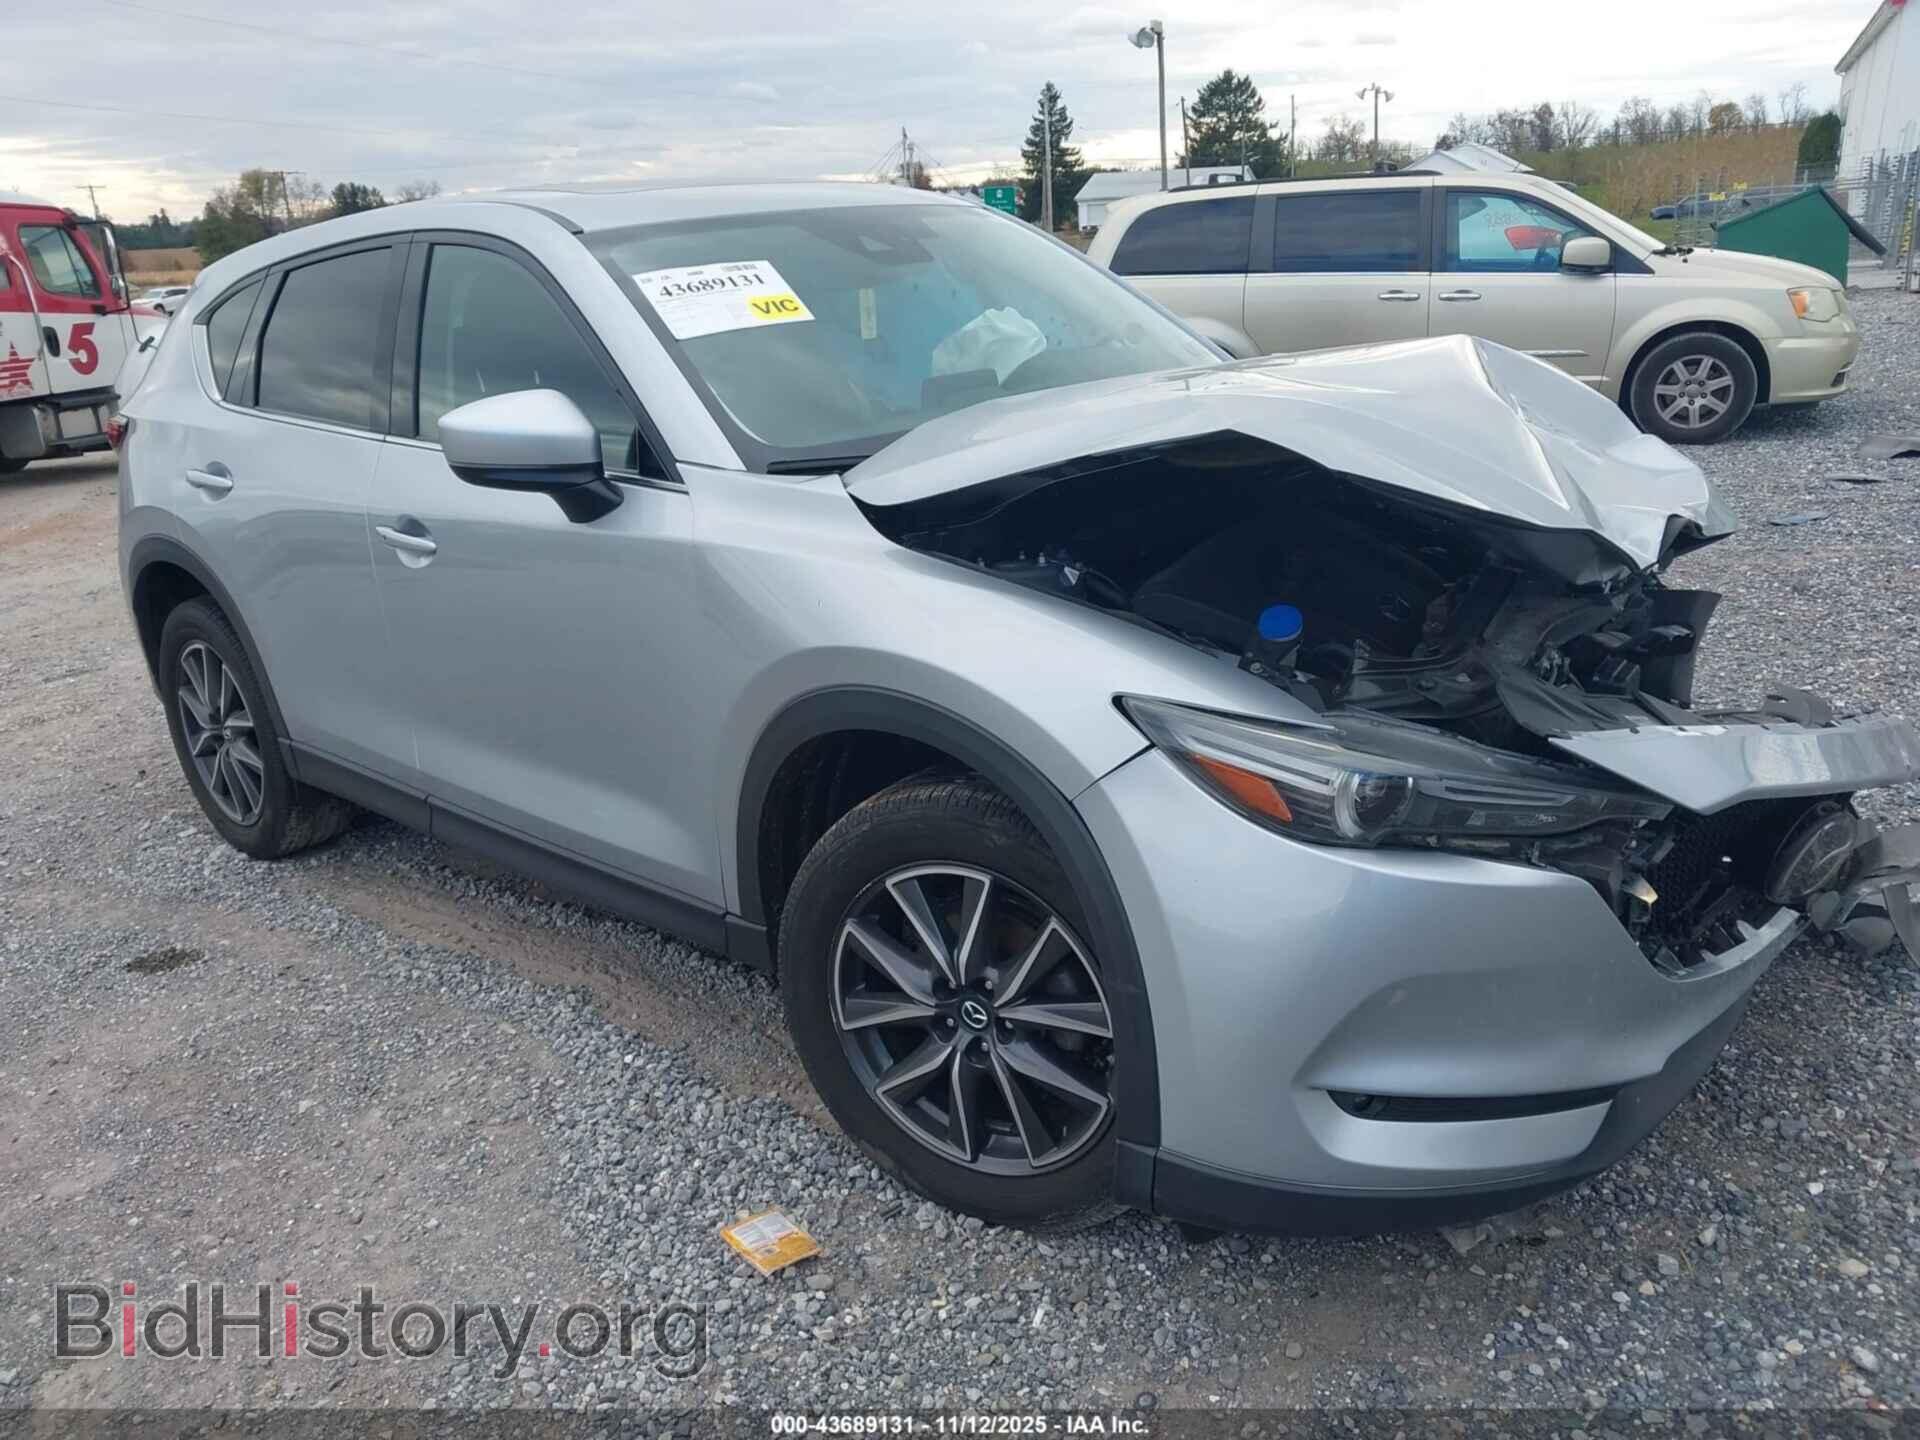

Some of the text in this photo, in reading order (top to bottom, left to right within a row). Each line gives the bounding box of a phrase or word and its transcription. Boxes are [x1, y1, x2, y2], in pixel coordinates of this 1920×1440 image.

[659, 273, 765, 297] 43689131
[751, 298, 800, 316] VIC
[67, 322, 99, 375] 5
